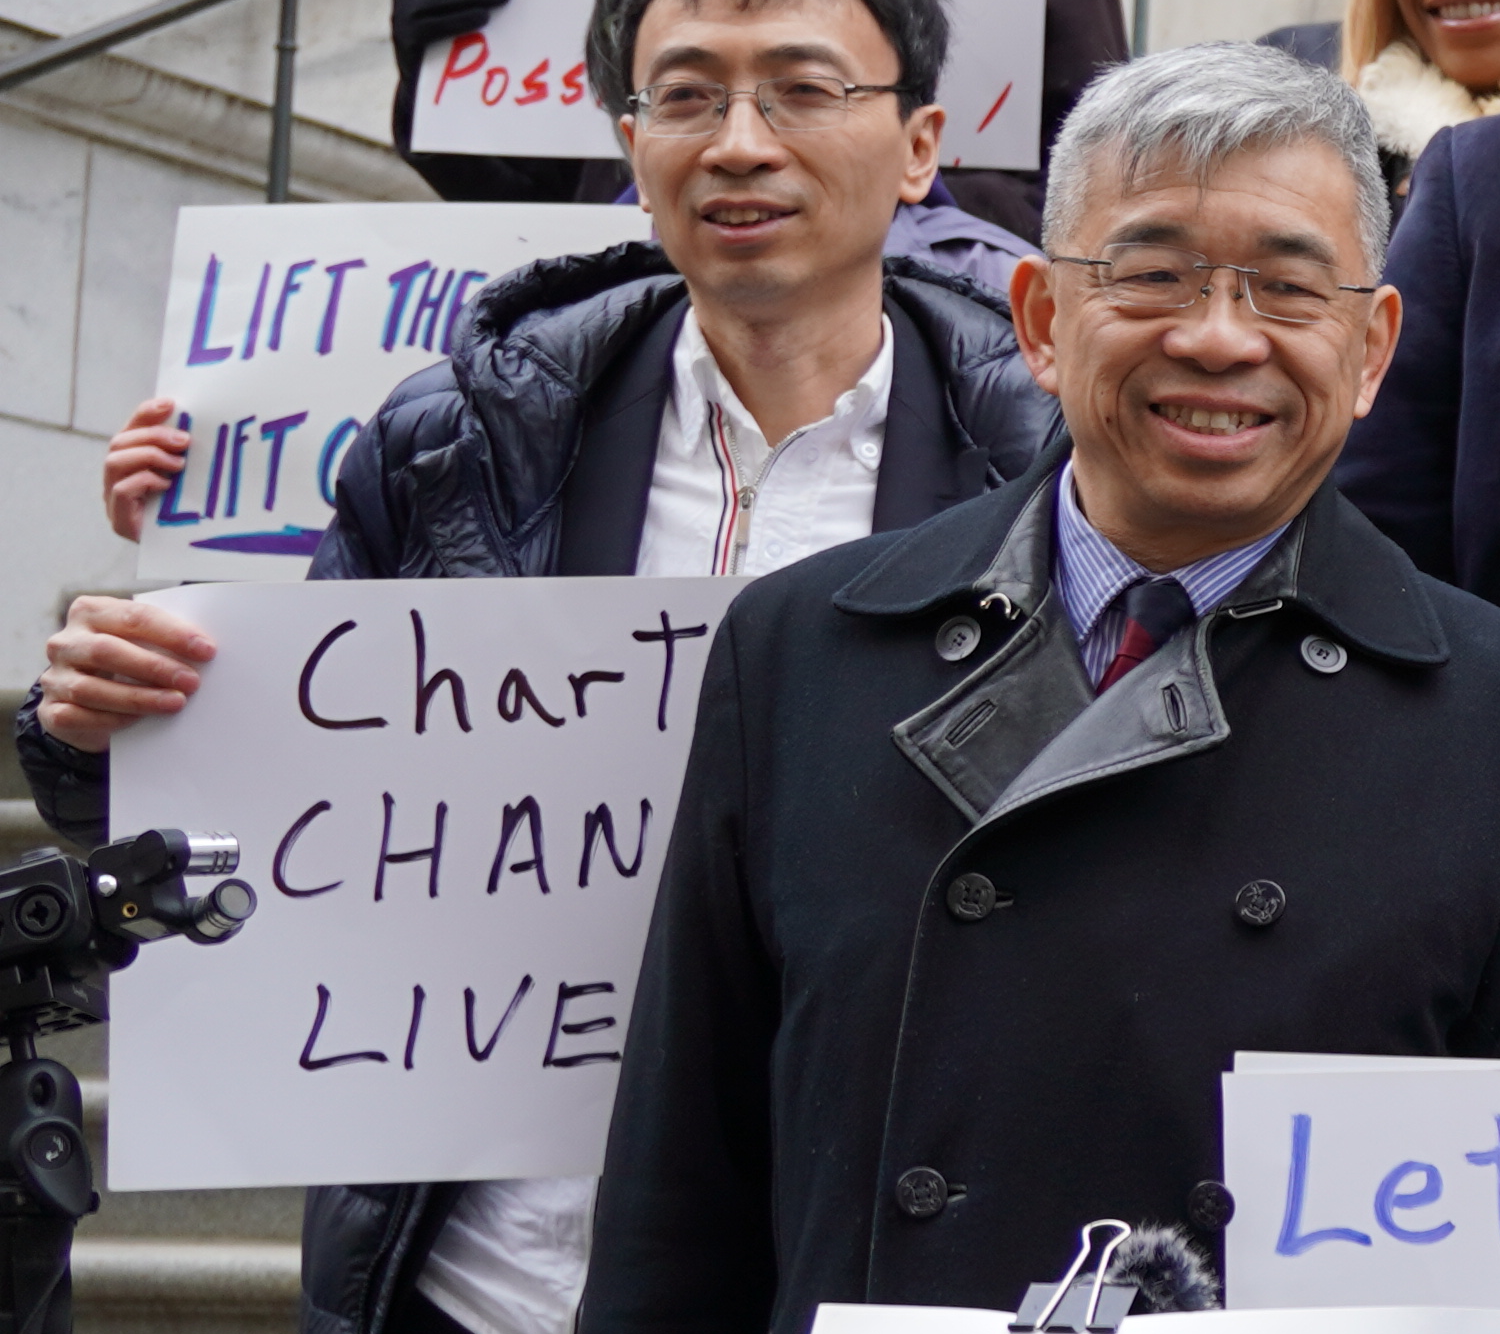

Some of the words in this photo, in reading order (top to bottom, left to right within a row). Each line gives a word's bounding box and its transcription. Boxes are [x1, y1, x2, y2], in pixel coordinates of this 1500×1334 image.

[186, 252, 368, 367] LIFT
[157, 410, 309, 527] LIFT
[298, 608, 709, 735] Chart
[272, 790, 654, 902] CHAN
